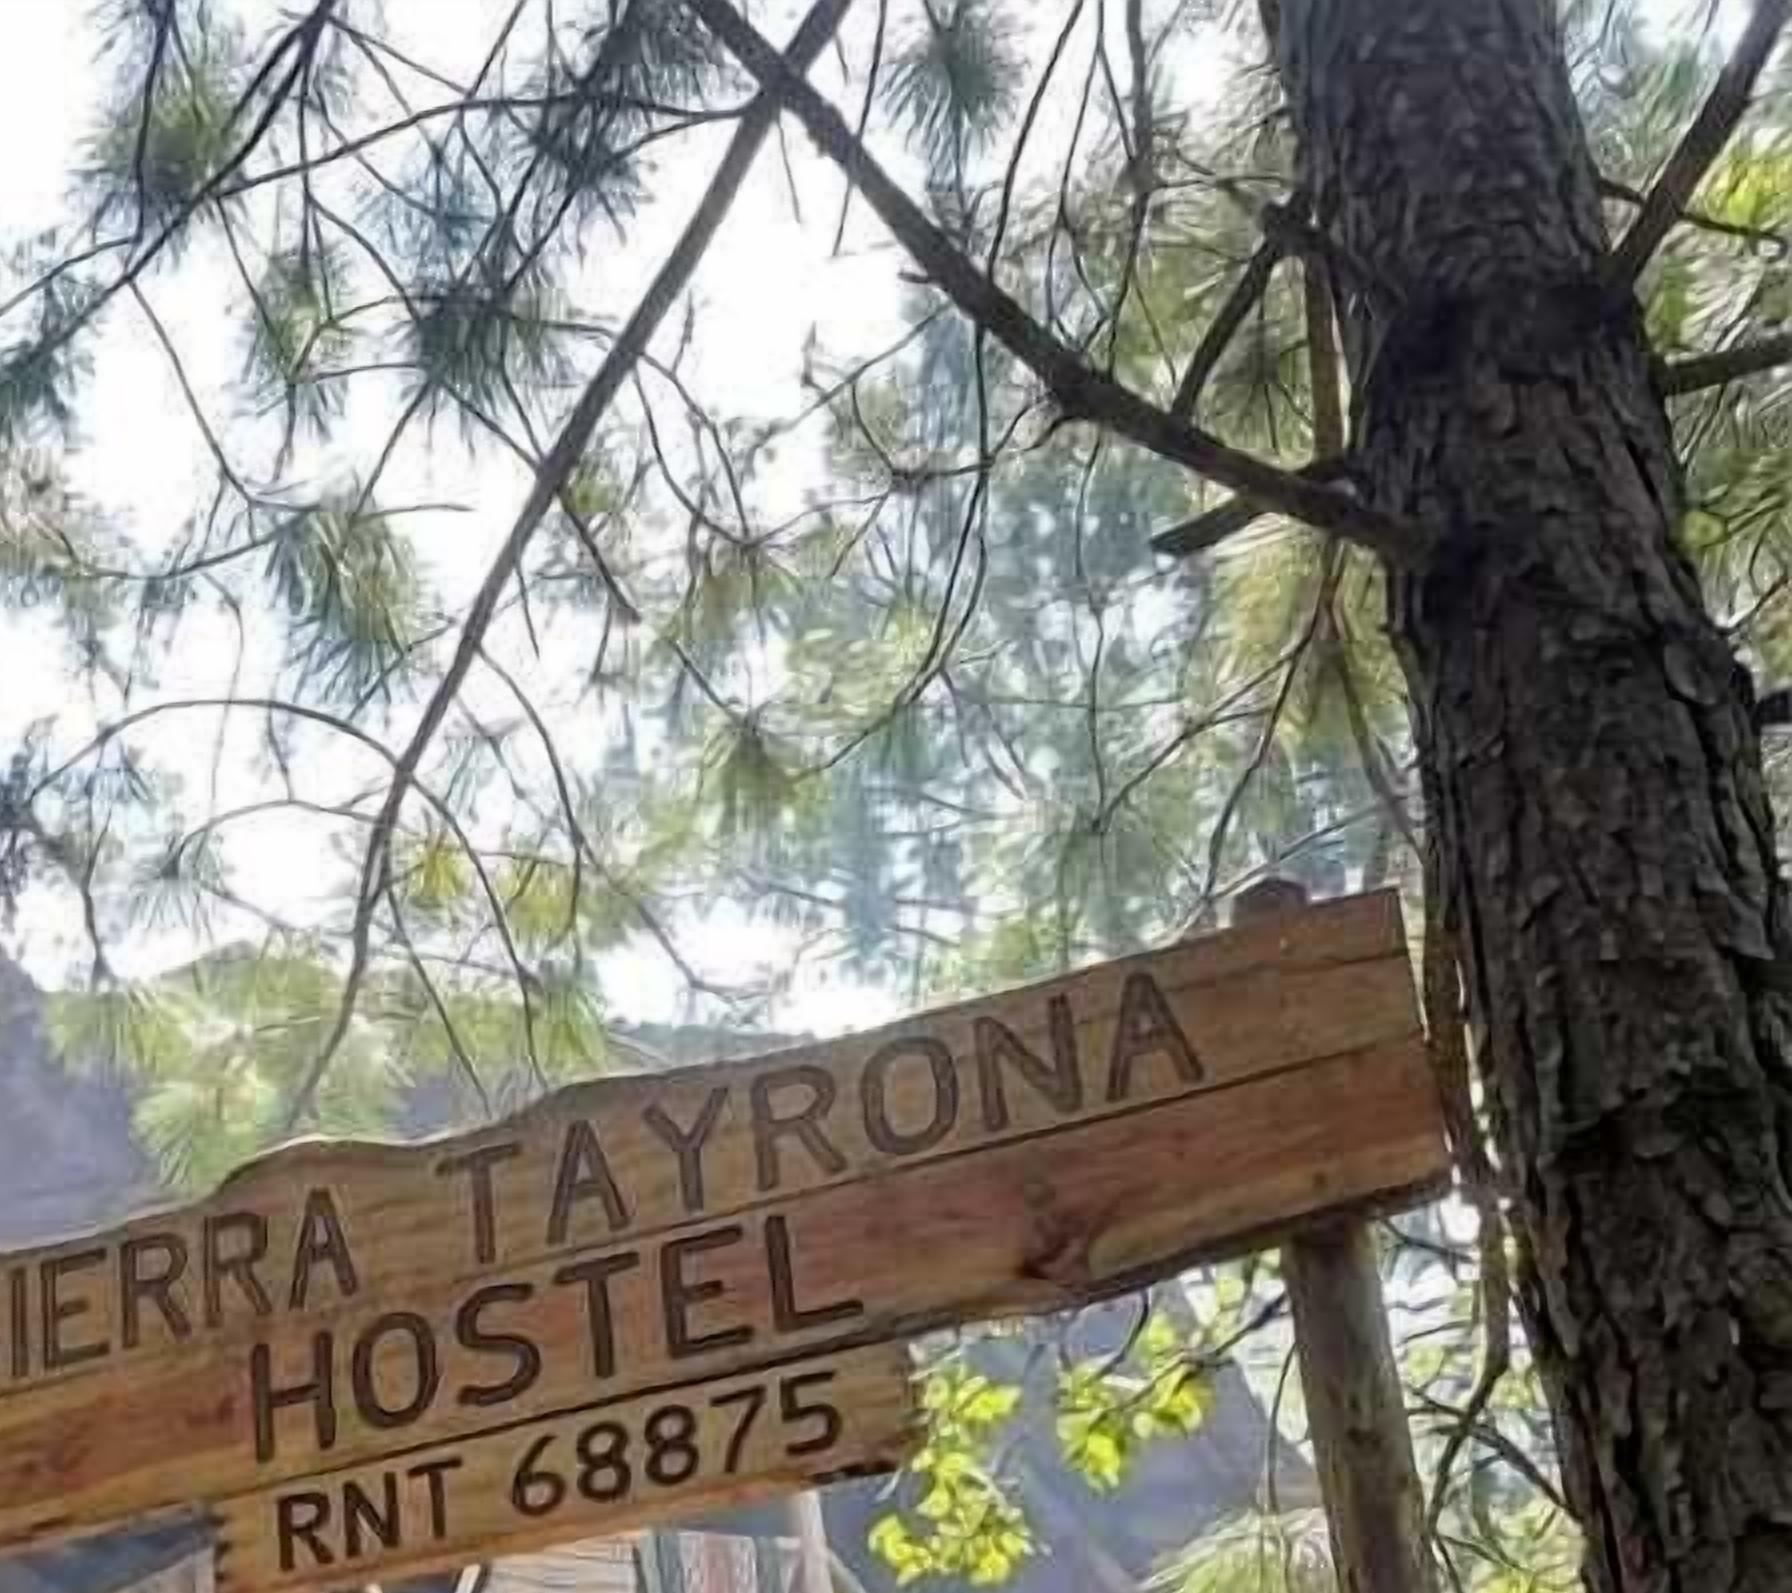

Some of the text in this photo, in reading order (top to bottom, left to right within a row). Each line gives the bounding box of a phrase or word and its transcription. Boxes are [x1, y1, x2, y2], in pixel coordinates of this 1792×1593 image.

[436, 971, 1204, 1263] TAYRONA
[251, 1215, 864, 1463] HOSTEL
[275, 1369, 843, 1571] RNT 68875
